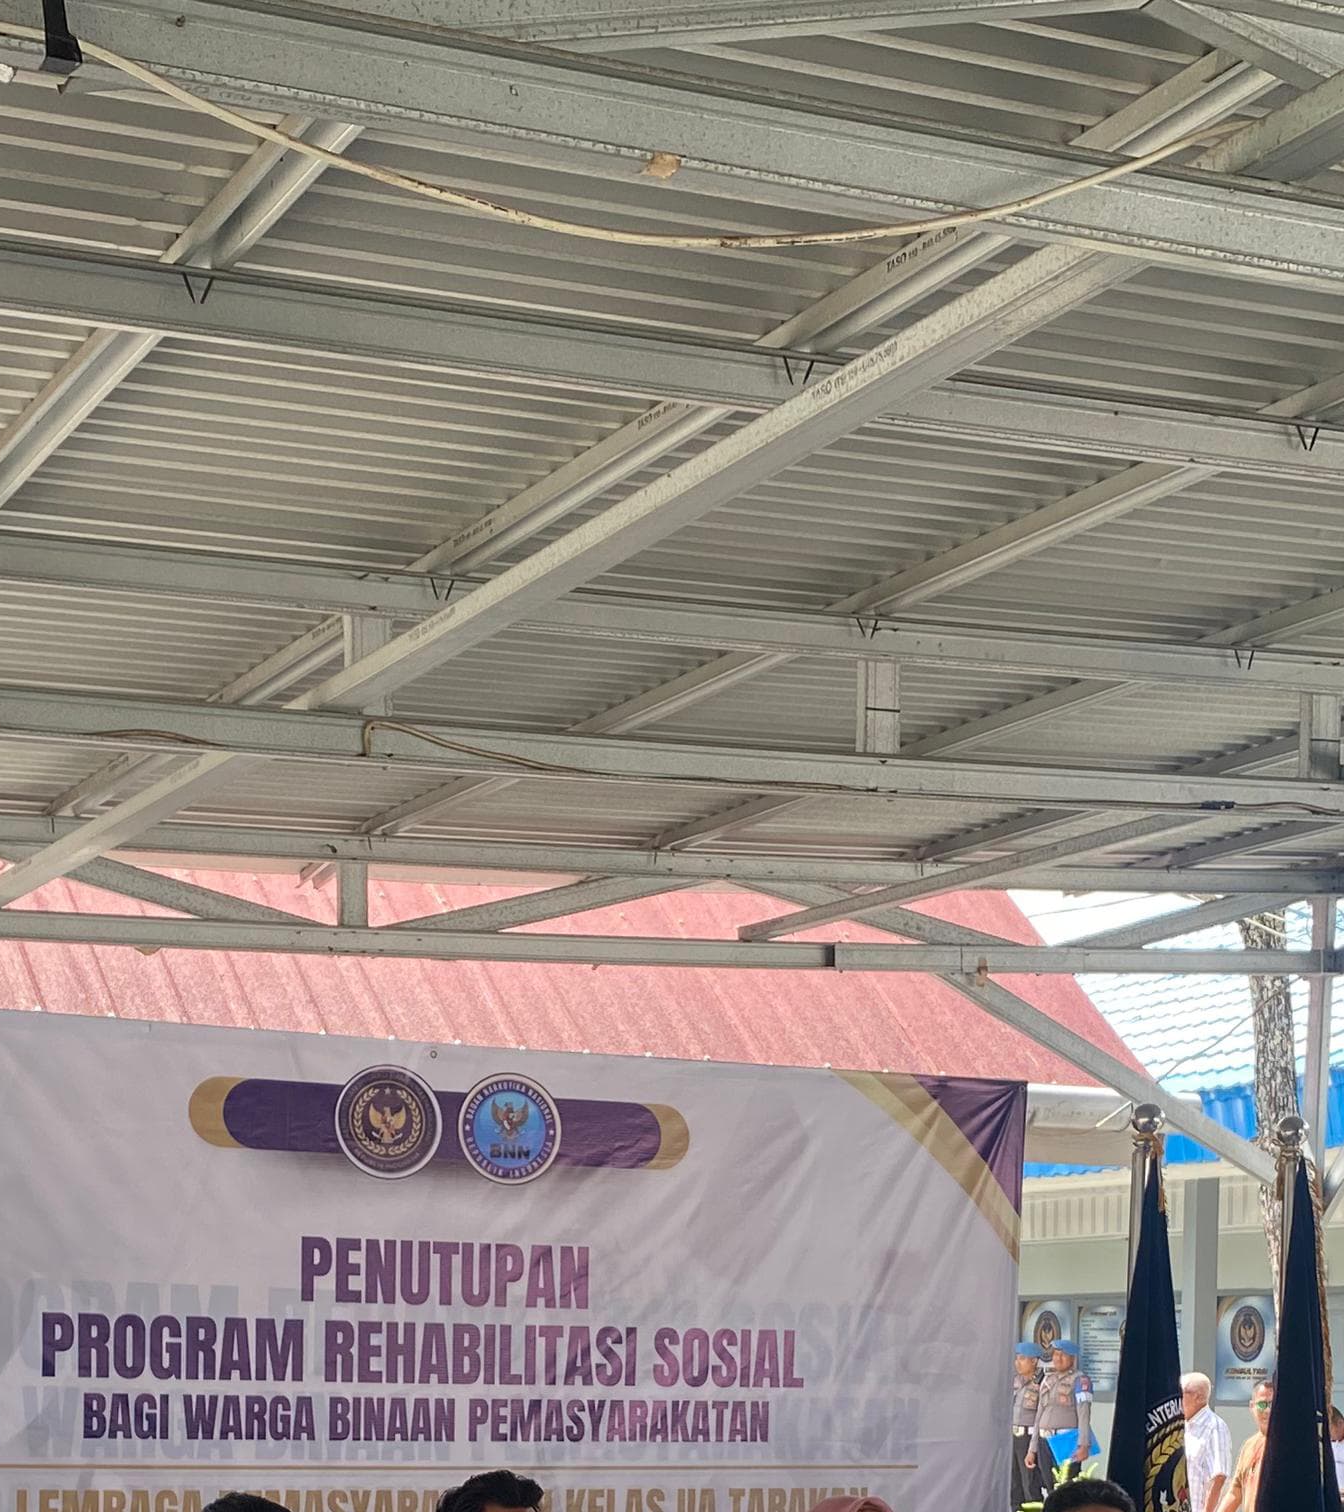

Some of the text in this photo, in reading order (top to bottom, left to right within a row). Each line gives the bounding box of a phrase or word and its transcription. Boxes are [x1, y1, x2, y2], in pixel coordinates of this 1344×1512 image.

[489, 1142, 531, 1160] BNN
[300, 1236, 590, 1310] PENUTUPAN
[41, 1311, 804, 1389] PROGRAM REHABILITASI SOSIAL
[82, 1393, 170, 1440] BAGI
[185, 1394, 316, 1442] WARGA
[329, 1395, 455, 1443] BINAAN
[467, 1397, 770, 1444] PEMASYARAKATAN
